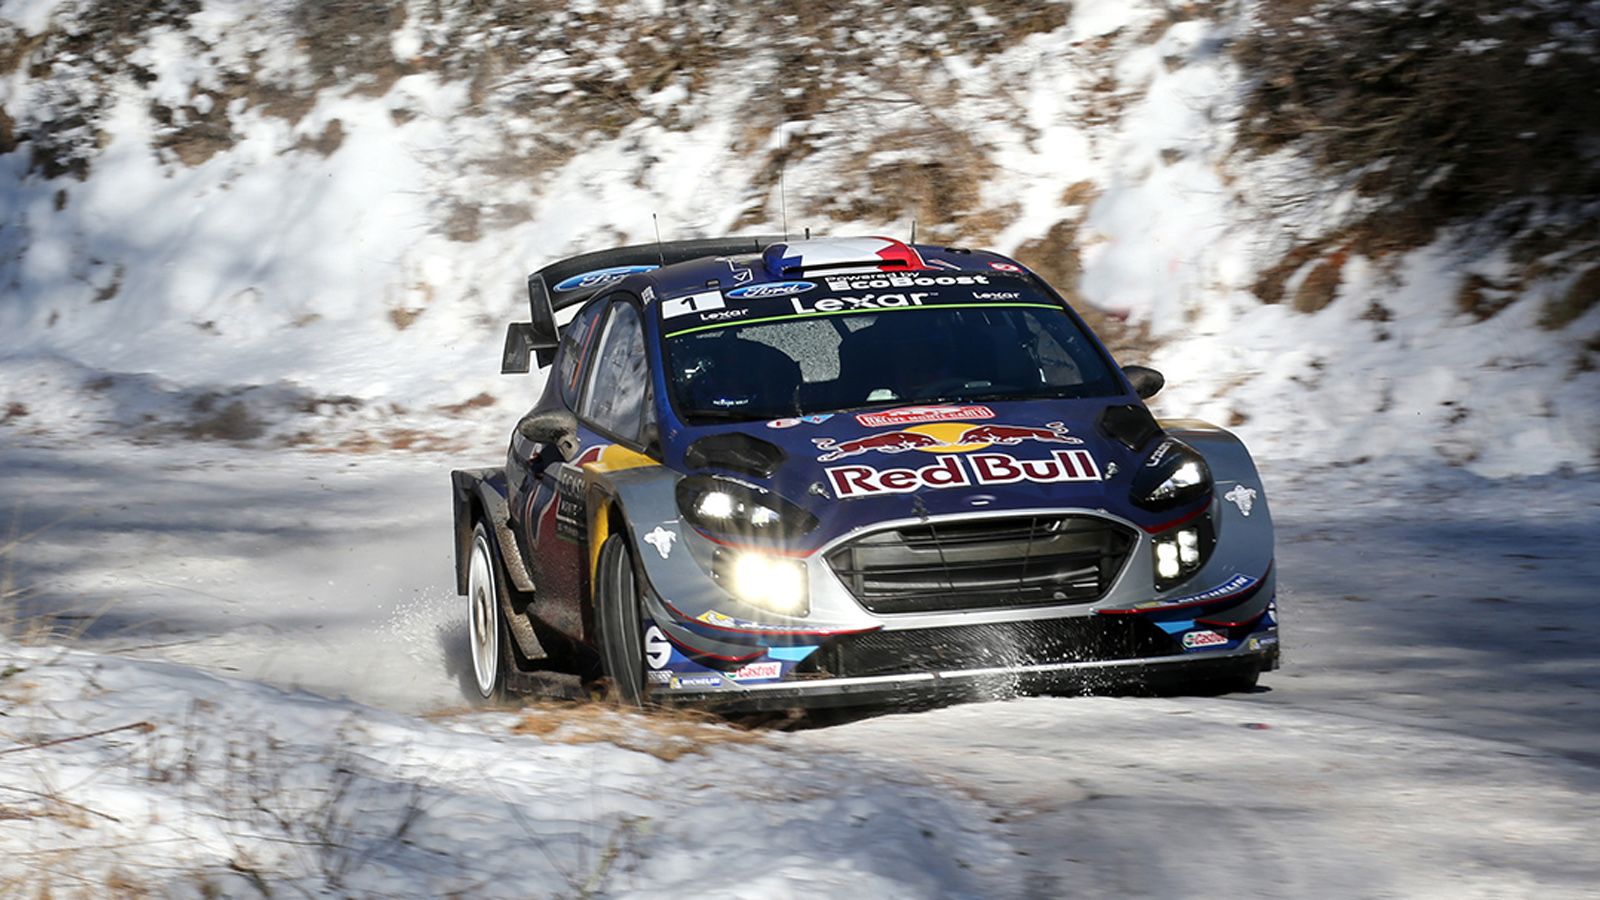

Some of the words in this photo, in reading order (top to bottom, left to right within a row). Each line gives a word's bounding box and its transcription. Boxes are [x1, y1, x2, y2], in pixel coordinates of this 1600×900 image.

[825, 274, 896, 283] Powered
[900, 272, 920, 281] by
[828, 275, 990, 292] EcoBoost
[743, 284, 799, 298] Ford
[972, 291, 1021, 300] Lexar
[681, 297, 697, 311] 1
[700, 308, 750, 321] Lexar
[829, 456, 965, 497] Red
[970, 451, 1098, 483] Bull
[737, 664, 778, 679] Castrol
